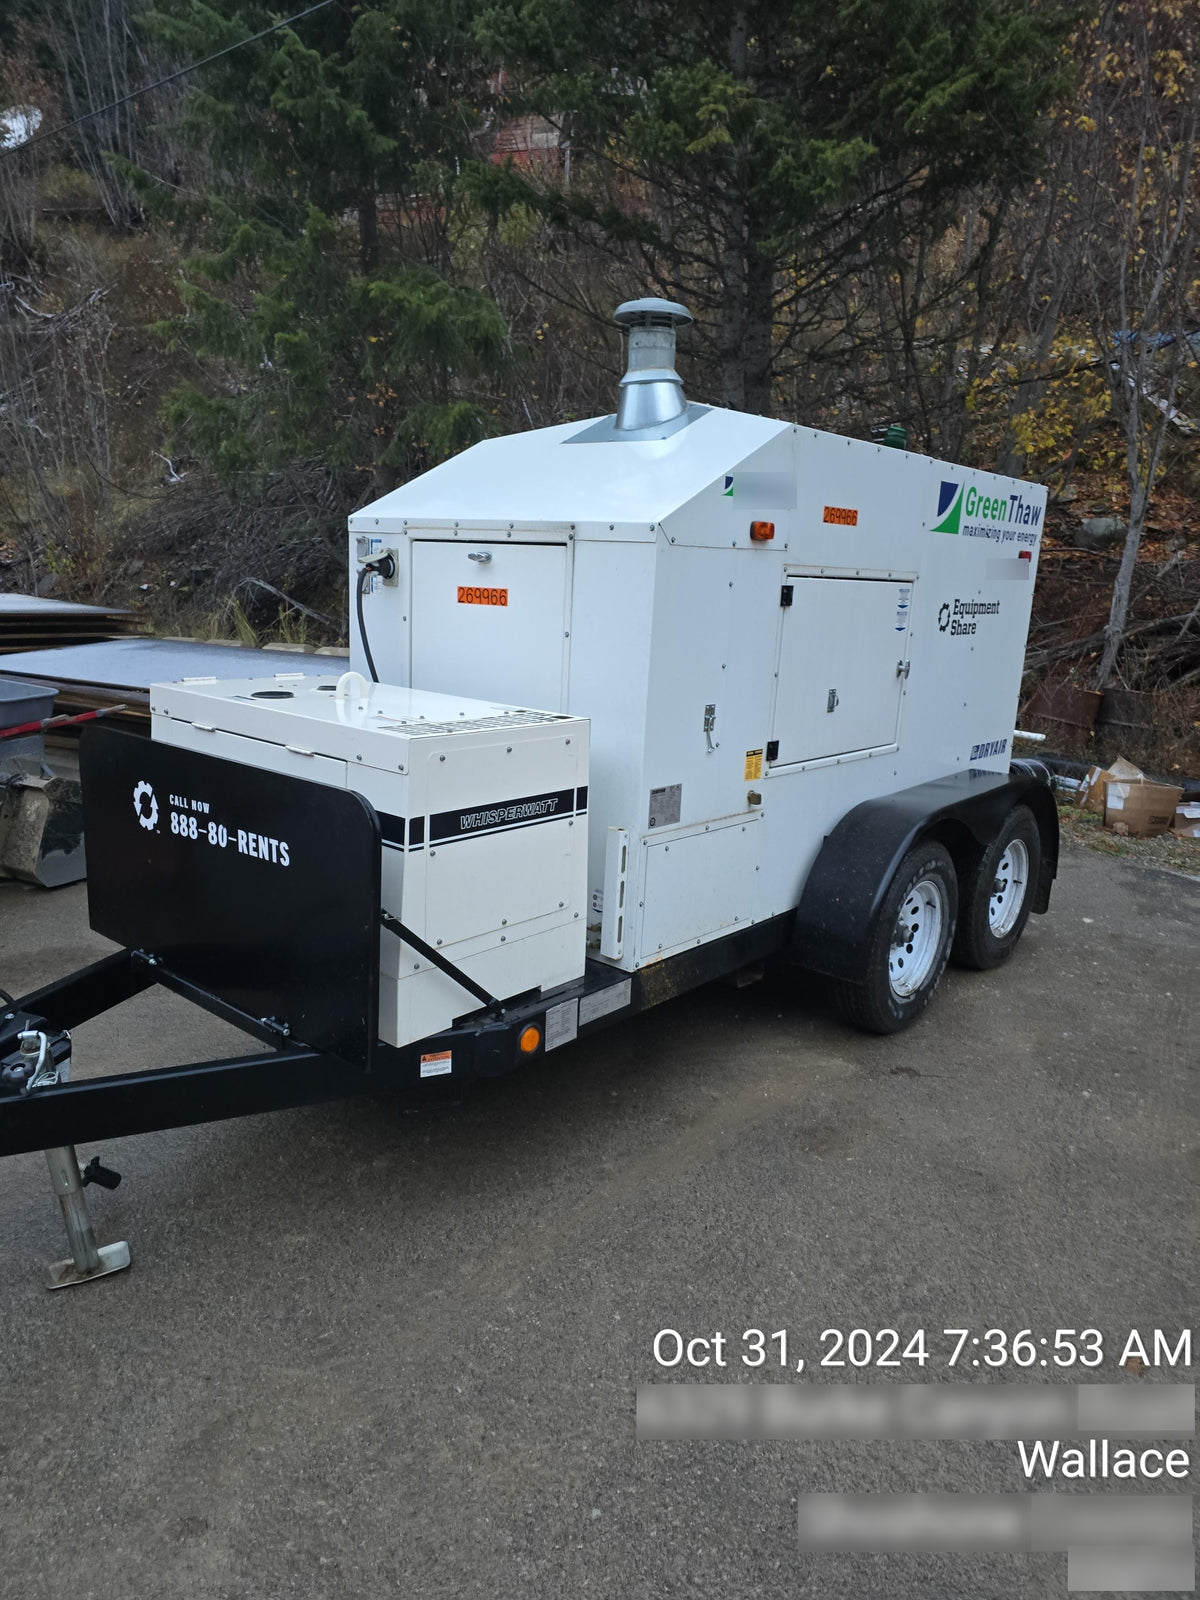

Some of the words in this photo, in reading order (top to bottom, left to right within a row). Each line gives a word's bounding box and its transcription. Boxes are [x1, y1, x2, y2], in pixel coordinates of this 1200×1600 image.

[823, 506, 858, 526] 269966
[962, 523, 1001, 543] maximizing
[1001, 530, 1017, 543] your
[1017, 531, 1038, 546] energy
[457, 587, 508, 606] 269966
[952, 599, 1000, 618] Equipment
[950, 619, 977, 635] Share
[978, 739, 1007, 759] DRYAIR
[169, 794, 189, 809] CALL
[191, 799, 210, 814] NOW
[460, 798, 558, 829] WHISPERWATT
[170, 811, 290, 867] 888-80-RENTS
